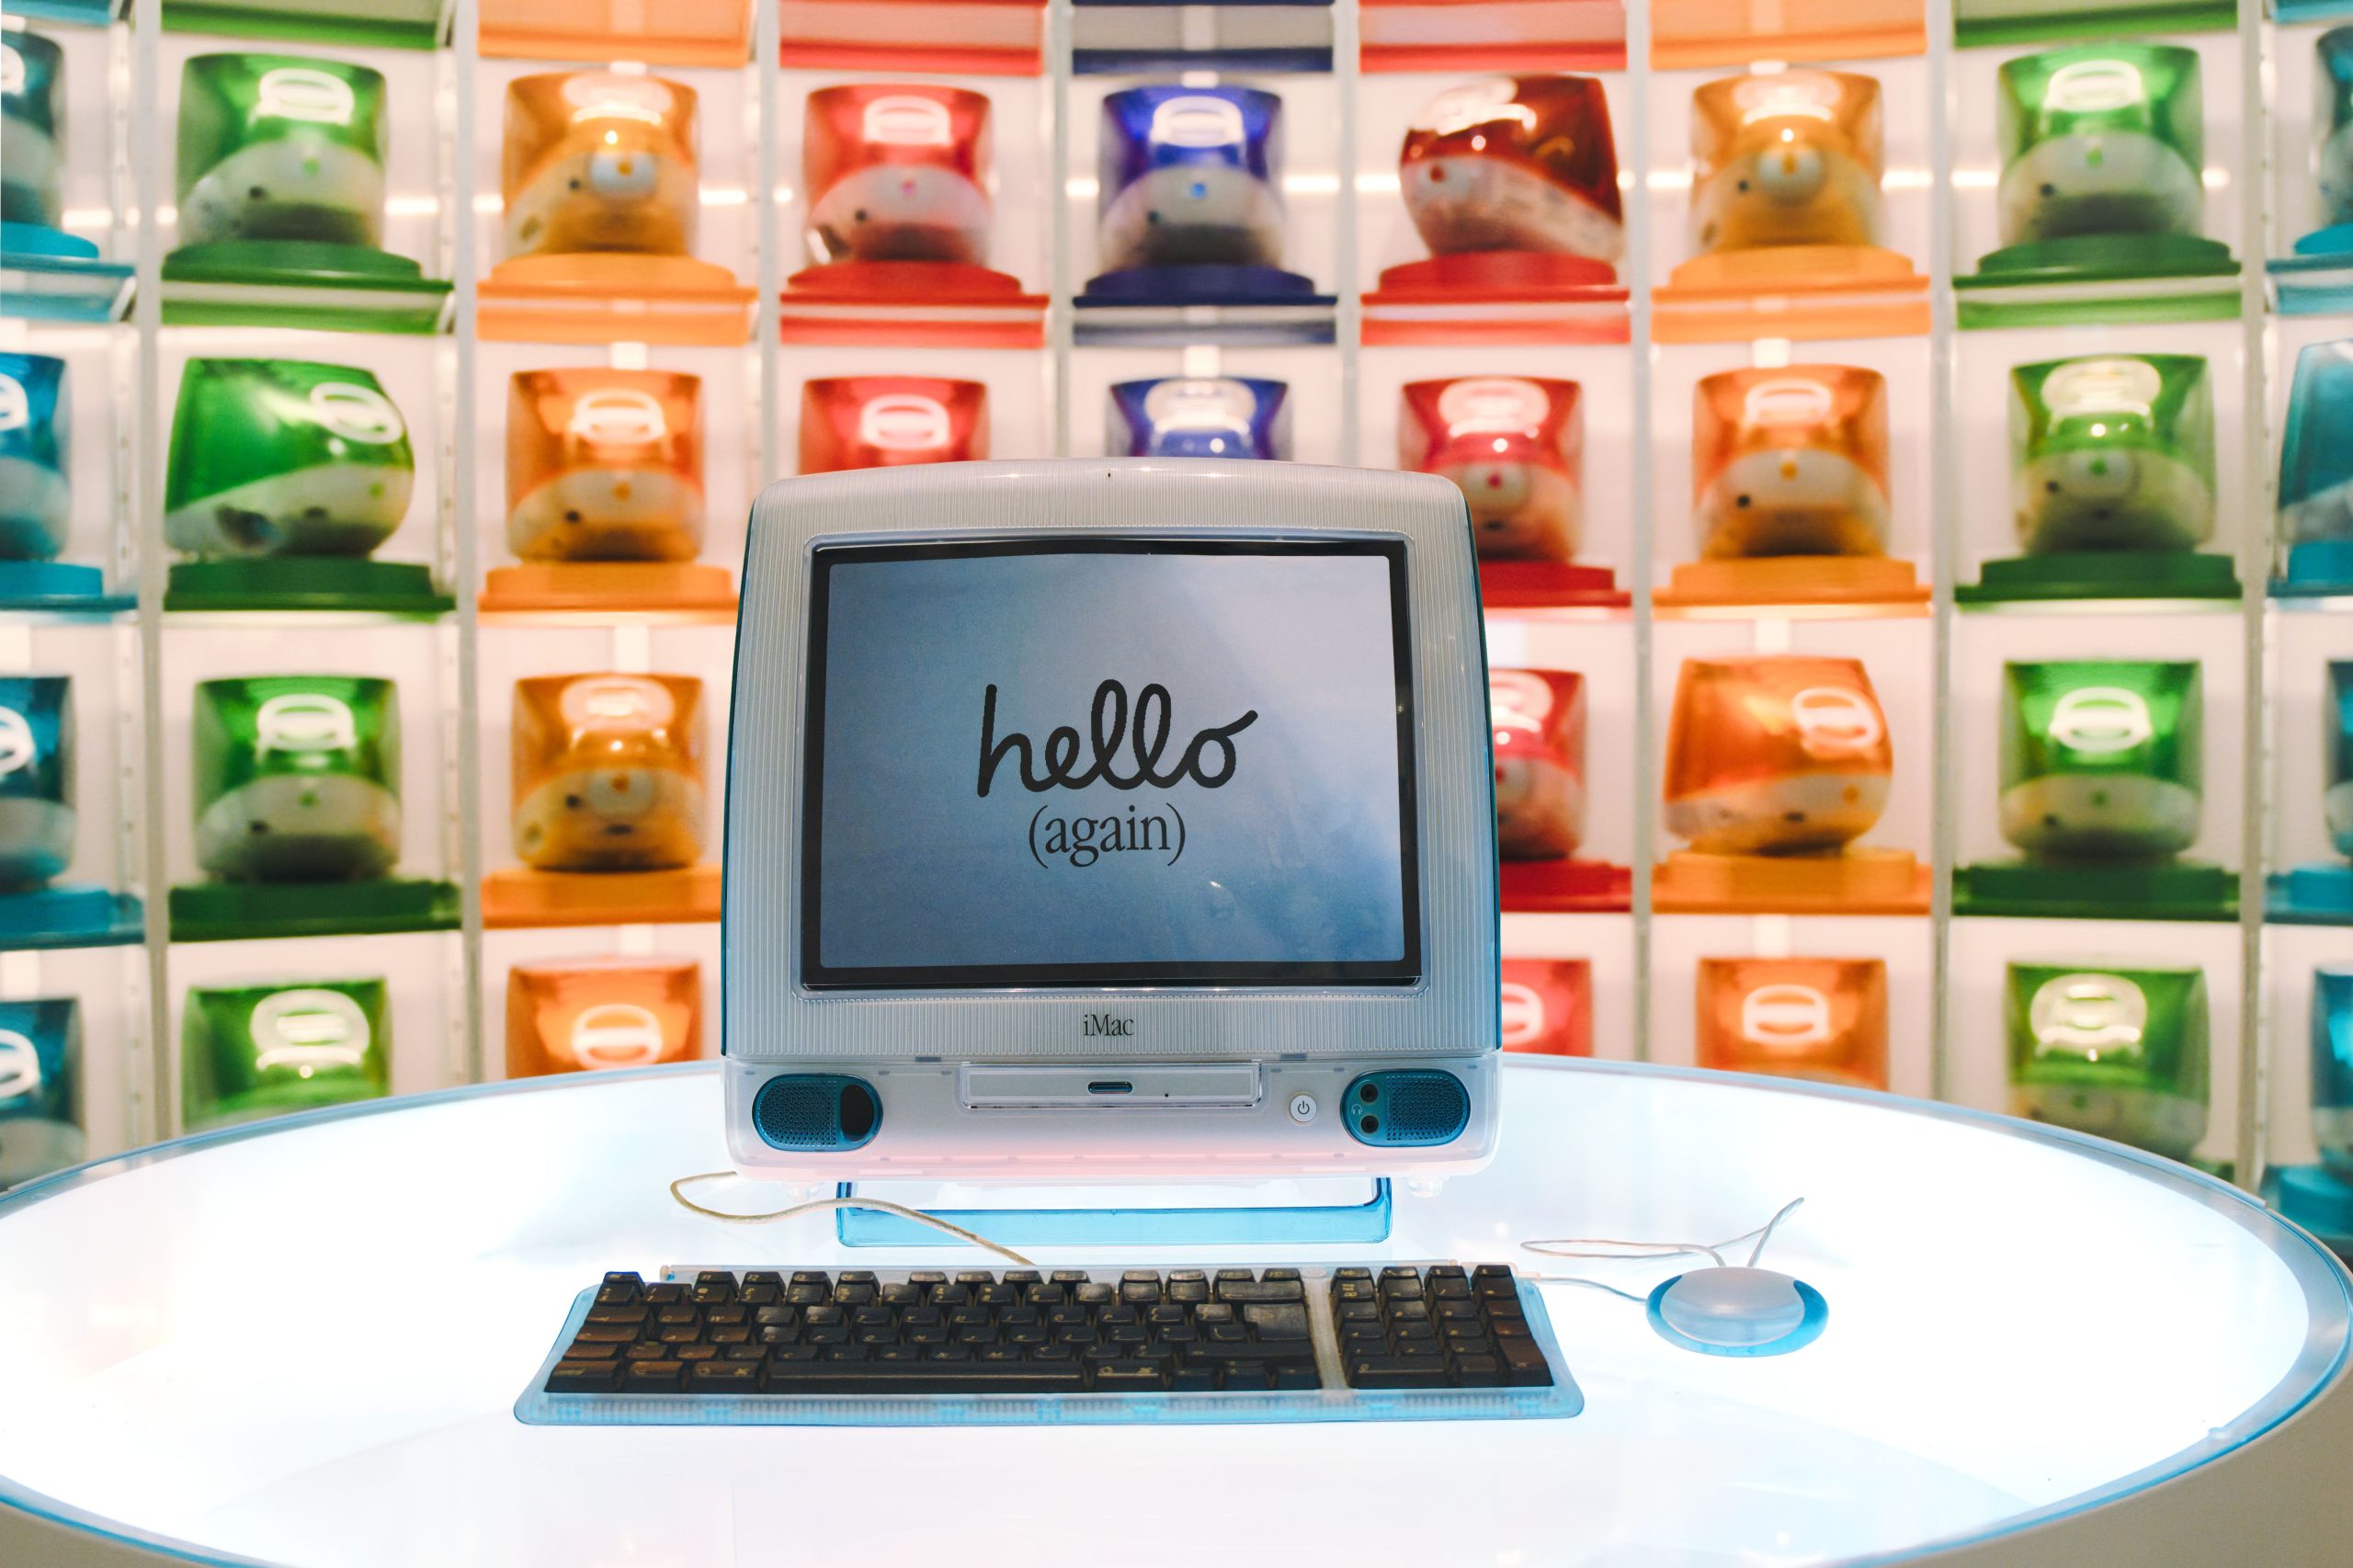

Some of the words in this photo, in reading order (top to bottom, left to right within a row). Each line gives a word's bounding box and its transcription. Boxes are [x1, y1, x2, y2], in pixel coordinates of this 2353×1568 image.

[977, 678, 1258, 798] hello
[1029, 802, 1186, 869] (again)
[1084, 1014, 1134, 1037] iMac
